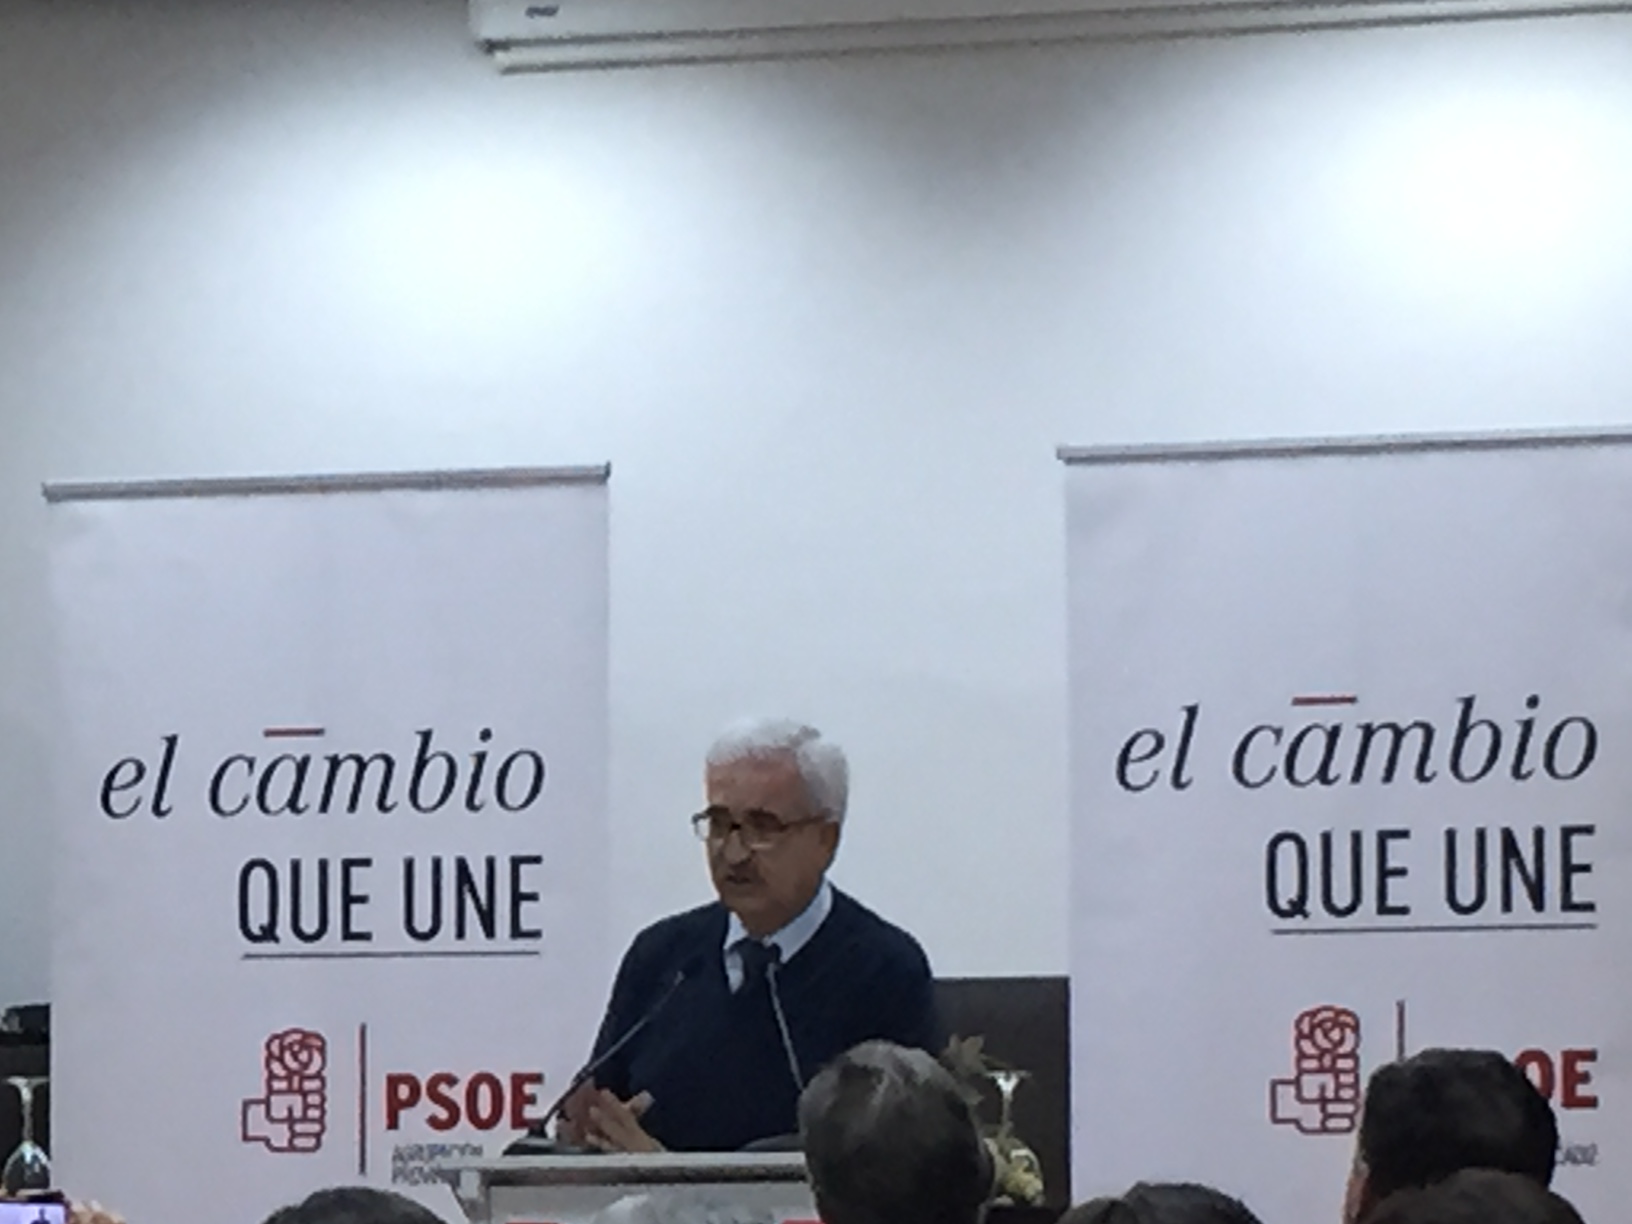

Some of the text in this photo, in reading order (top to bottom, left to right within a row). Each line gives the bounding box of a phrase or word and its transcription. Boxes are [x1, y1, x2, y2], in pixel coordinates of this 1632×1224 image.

[99, 728, 546, 820] el cambio
[1115, 694, 1598, 792] el cambio
[237, 855, 543, 944] QUE UNE
[1266, 825, 1597, 919] QUE UNE
[385, 1072, 544, 1131] PSOE
[1515, 1049, 1599, 1109] OE
